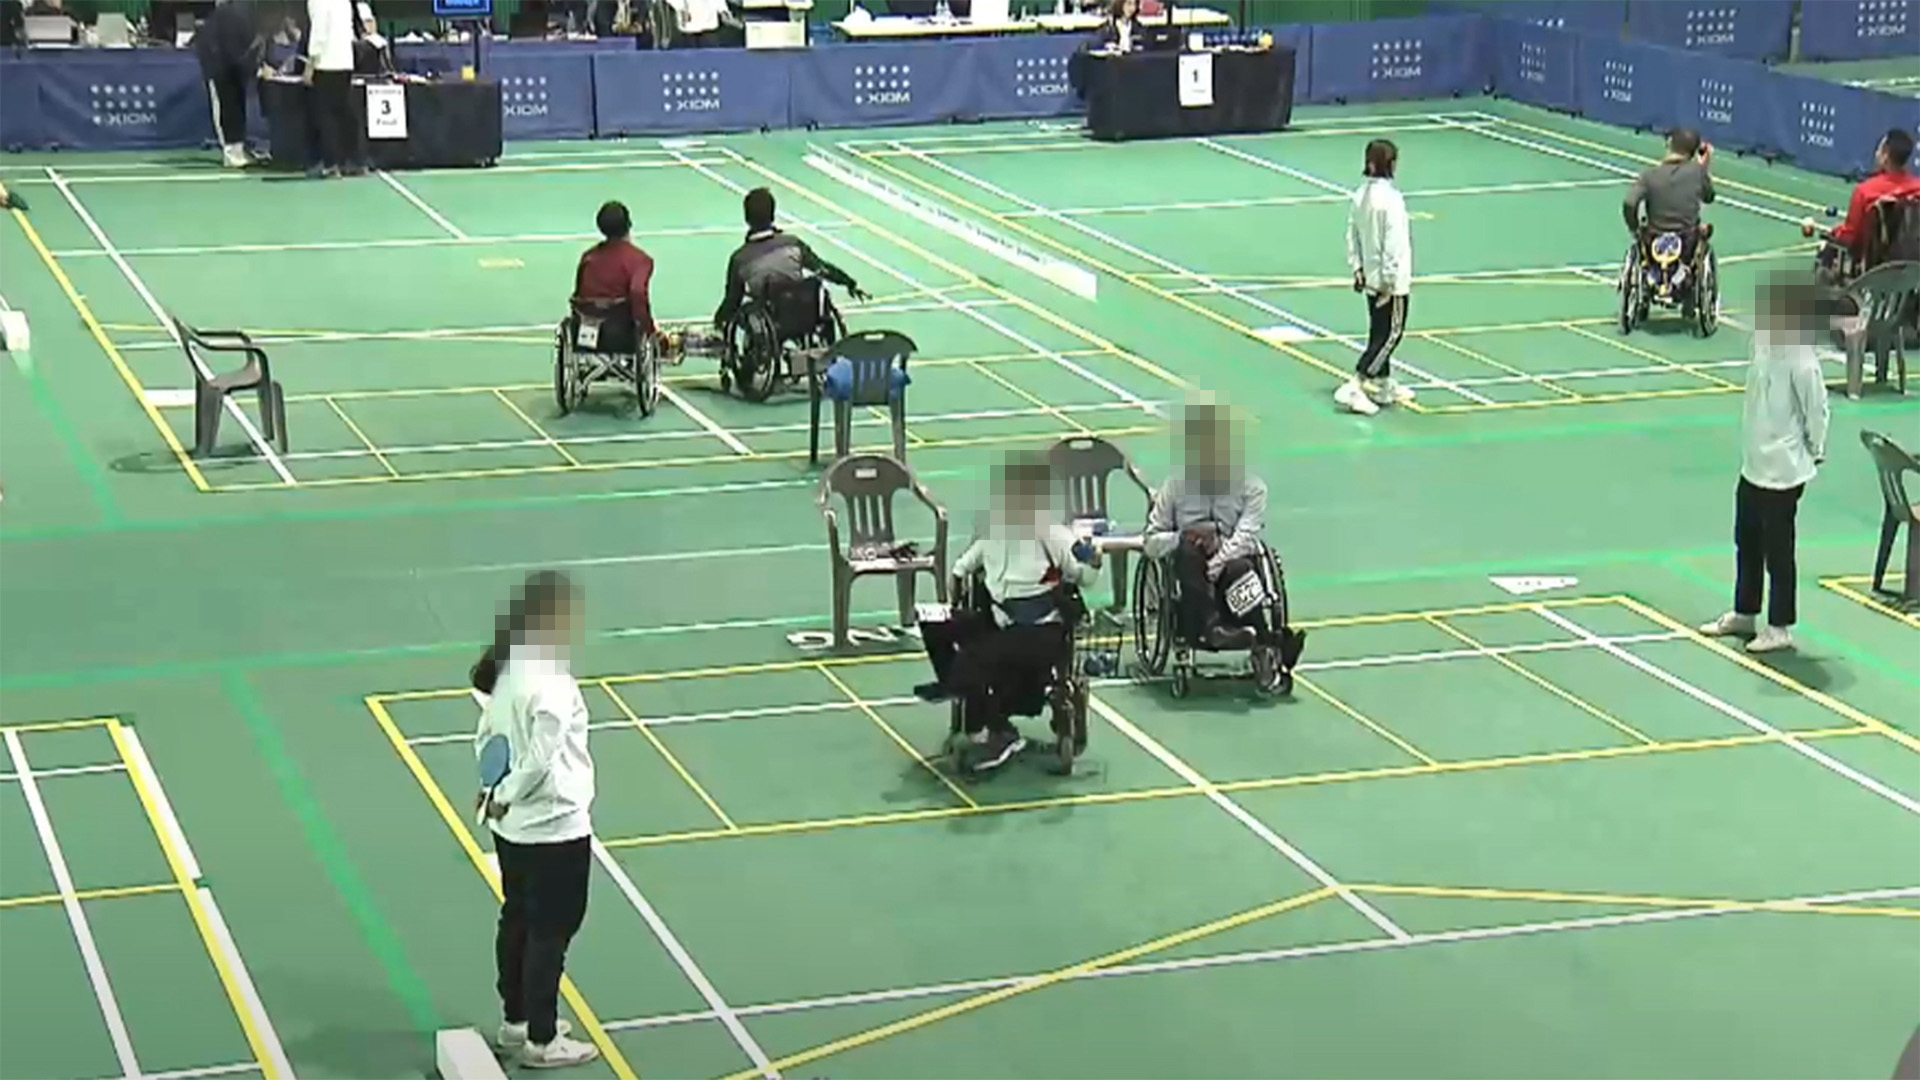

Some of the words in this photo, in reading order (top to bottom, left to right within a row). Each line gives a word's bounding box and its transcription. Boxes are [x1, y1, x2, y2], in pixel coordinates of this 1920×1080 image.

[867, 91, 911, 104] XIOM
[381, 99, 392, 115] 3
[676, 98, 720, 112] XIOM
